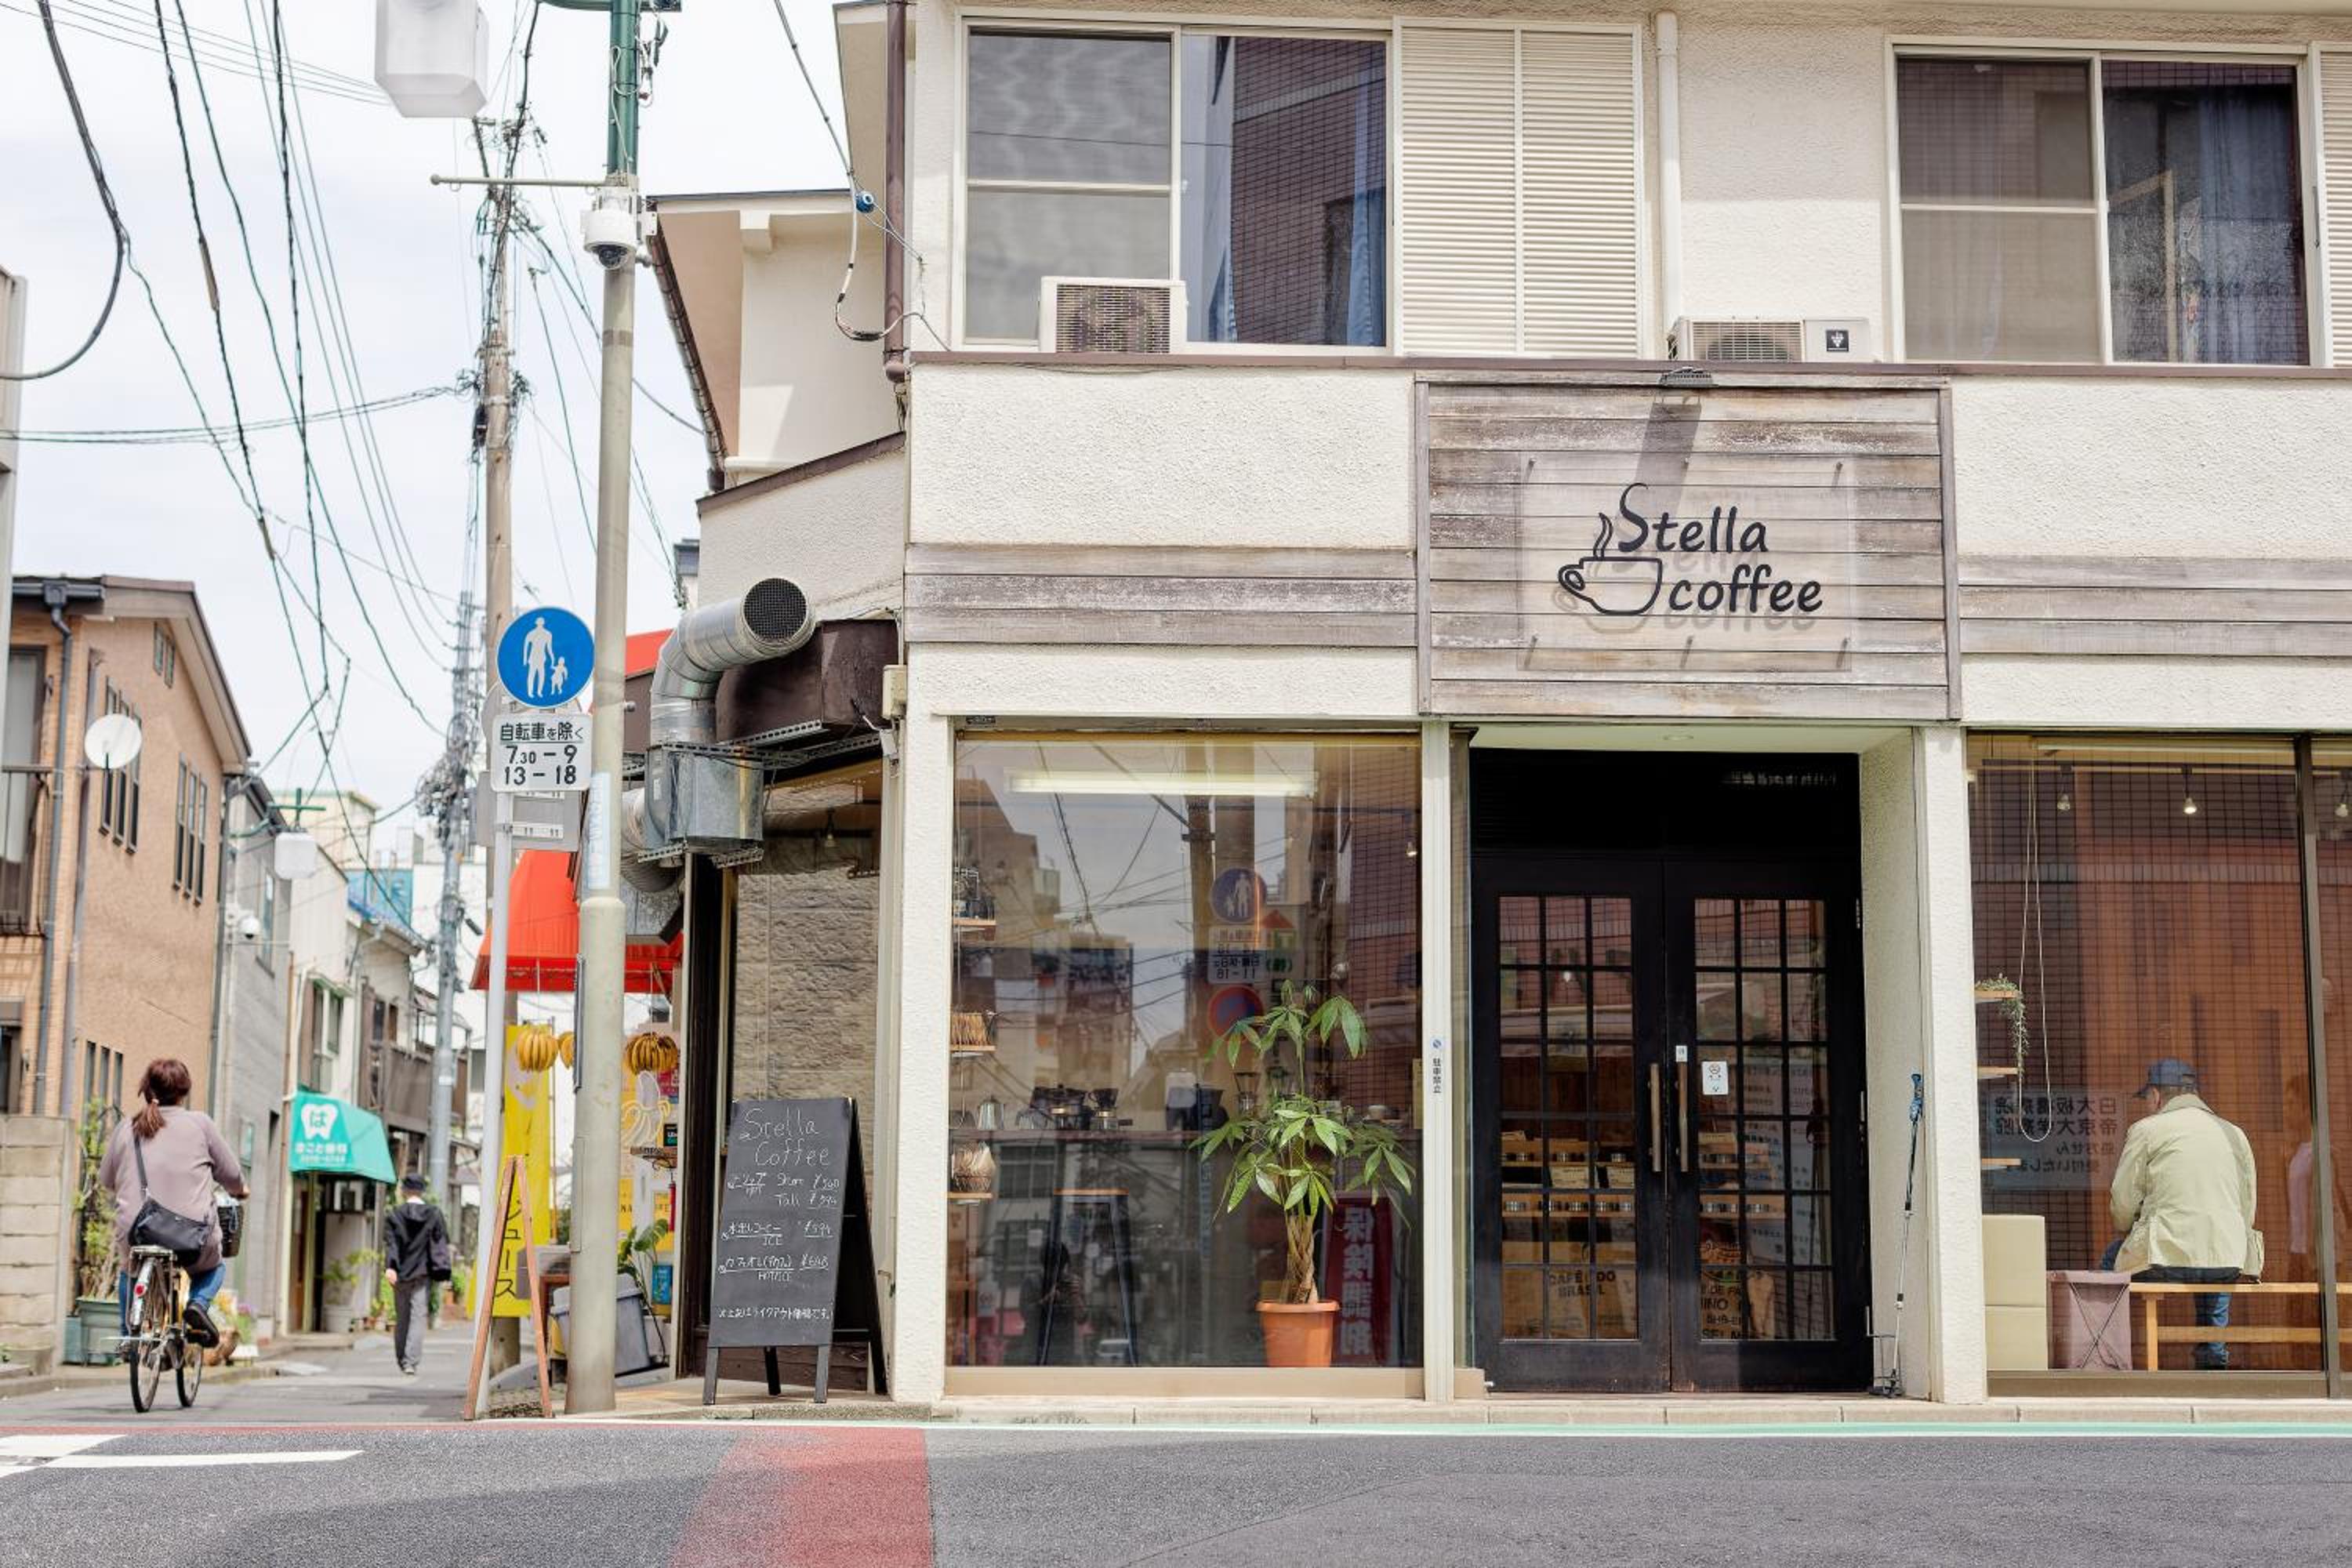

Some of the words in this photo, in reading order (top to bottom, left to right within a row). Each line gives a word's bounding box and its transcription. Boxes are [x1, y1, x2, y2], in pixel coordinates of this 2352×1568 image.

[1617, 481, 1769, 554] Stella
[1668, 564, 1824, 613] coffee
[500, 722, 585, 741] 自転車を除く
[310, 1110, 327, 1128] は
[754, 1138, 830, 1167] Coffee
[1558, 1283, 1606, 1297] BRASL
